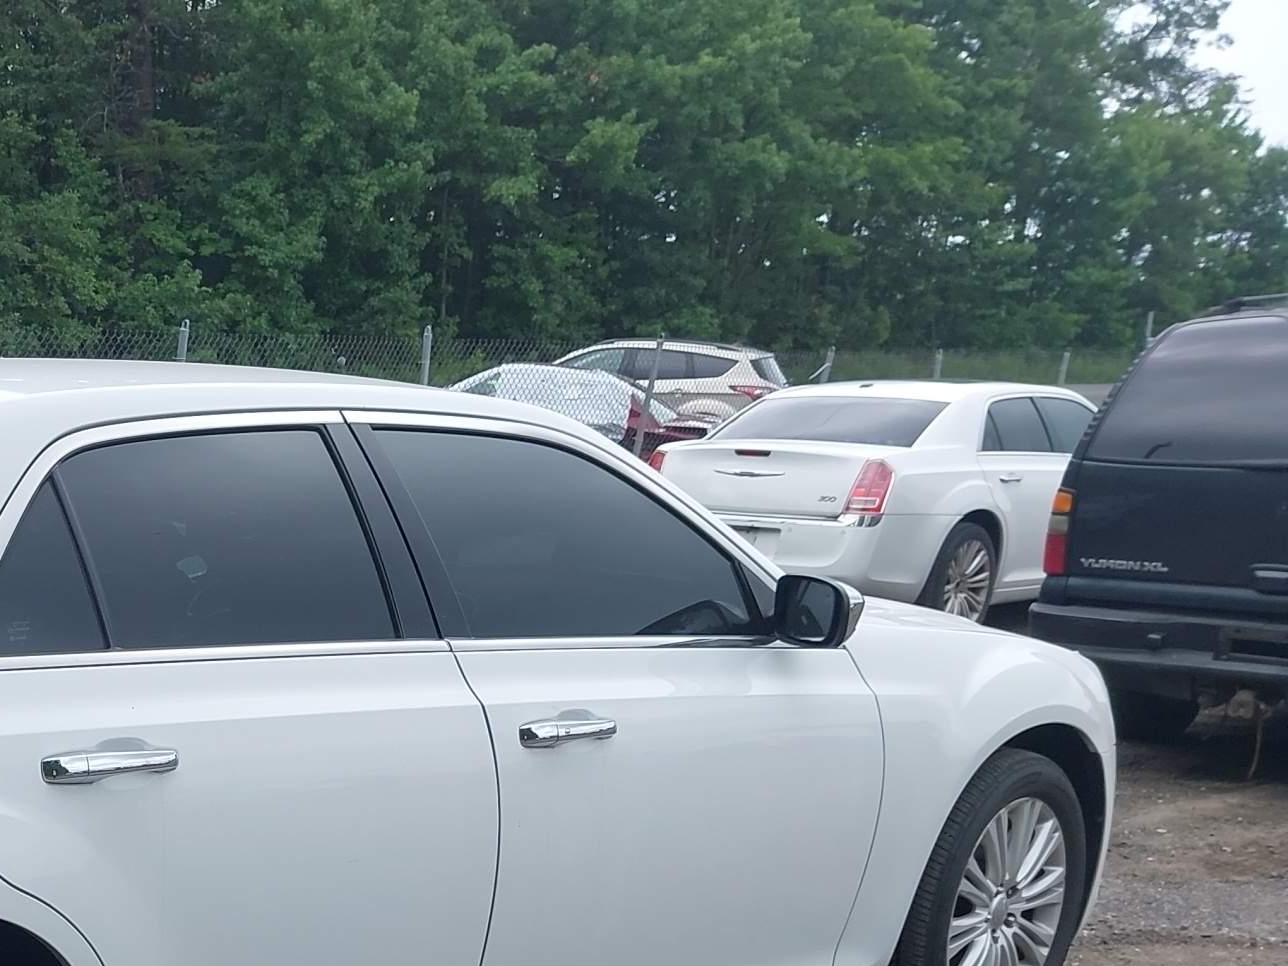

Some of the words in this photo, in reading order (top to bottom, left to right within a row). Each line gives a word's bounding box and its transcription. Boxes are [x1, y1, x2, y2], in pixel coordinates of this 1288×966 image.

[817, 495, 838, 503] 300
[1079, 557, 1141, 571] YUKON
[1142, 561, 1169, 572] XL
